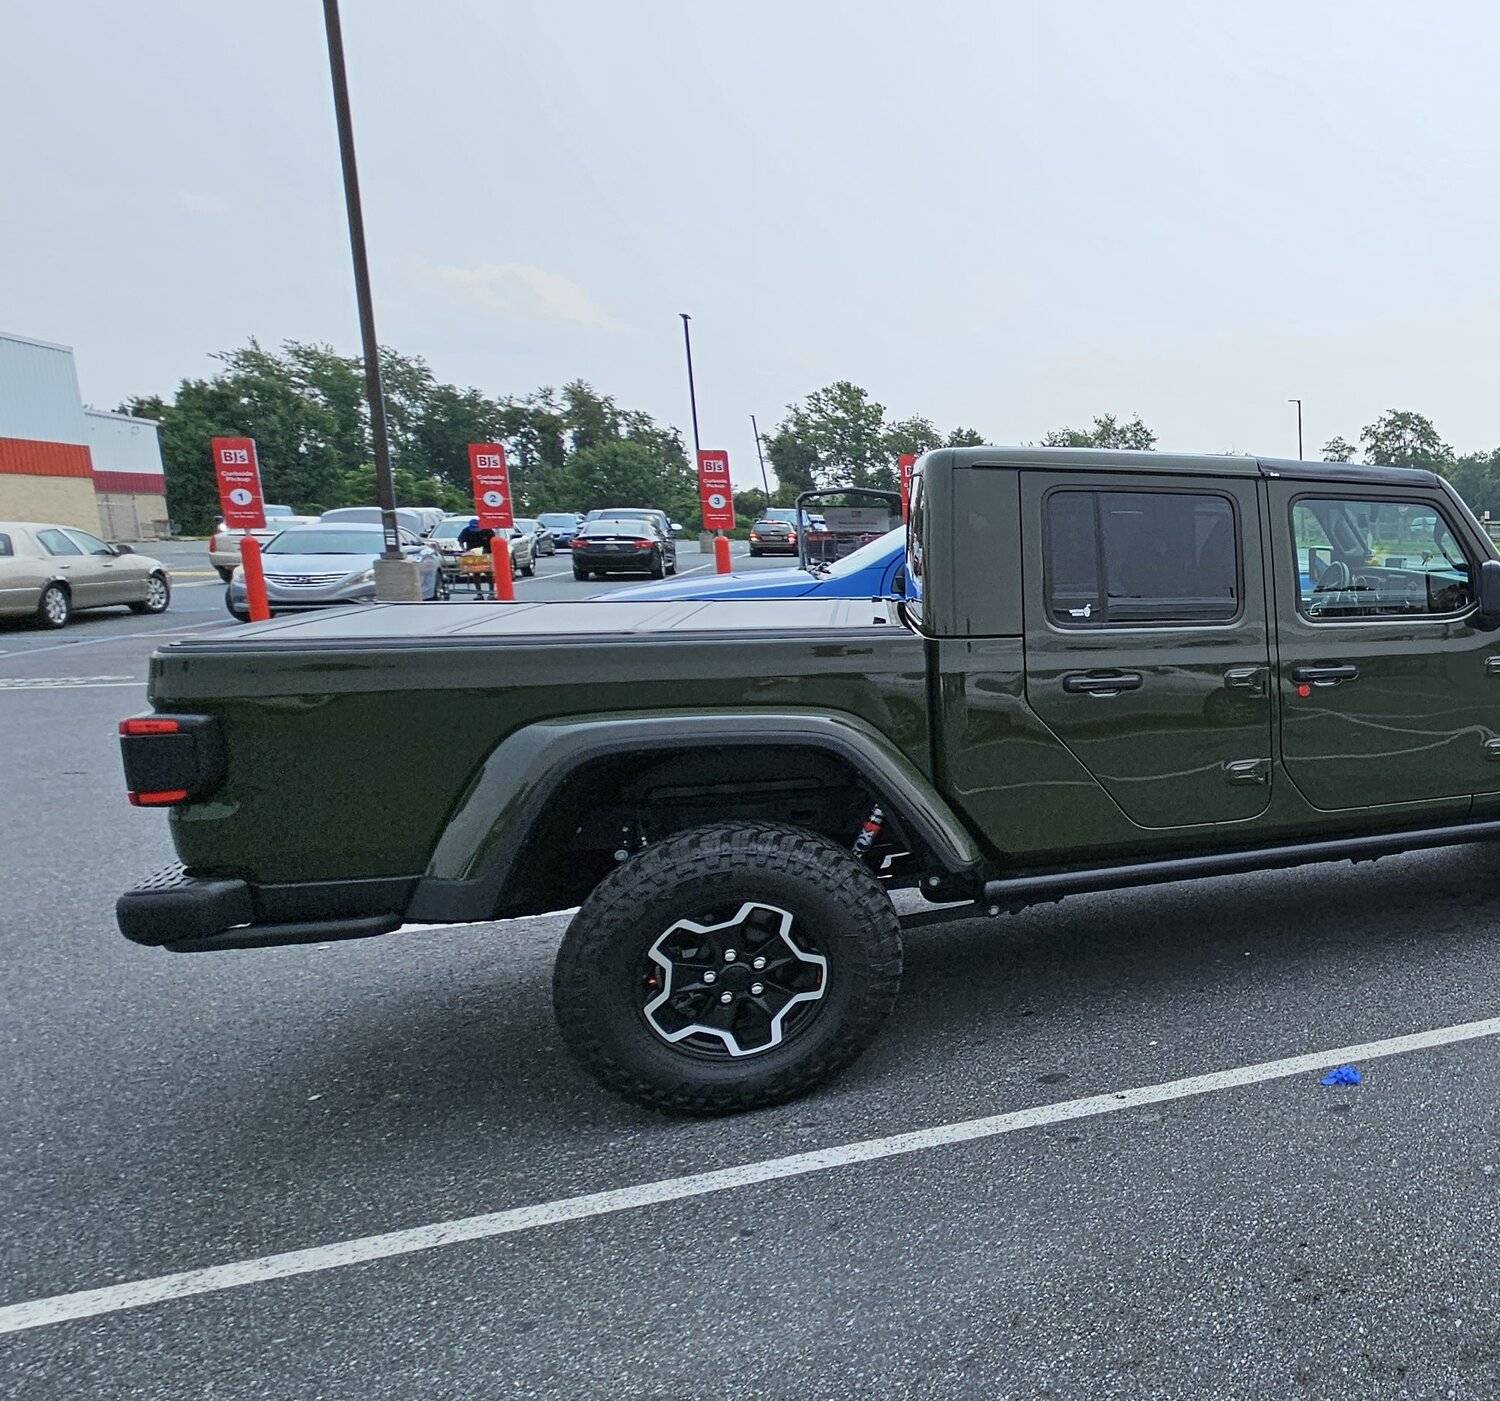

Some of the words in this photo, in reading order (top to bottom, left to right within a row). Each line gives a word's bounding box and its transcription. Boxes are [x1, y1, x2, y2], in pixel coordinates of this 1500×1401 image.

[223, 451, 247, 463] BJ's
[478, 456, 499, 467] BJ's
[705, 461, 723, 471] BJ's
[237, 493, 244, 501] 1
[489, 494, 497, 503] 2
[713, 497, 721, 505] 3
